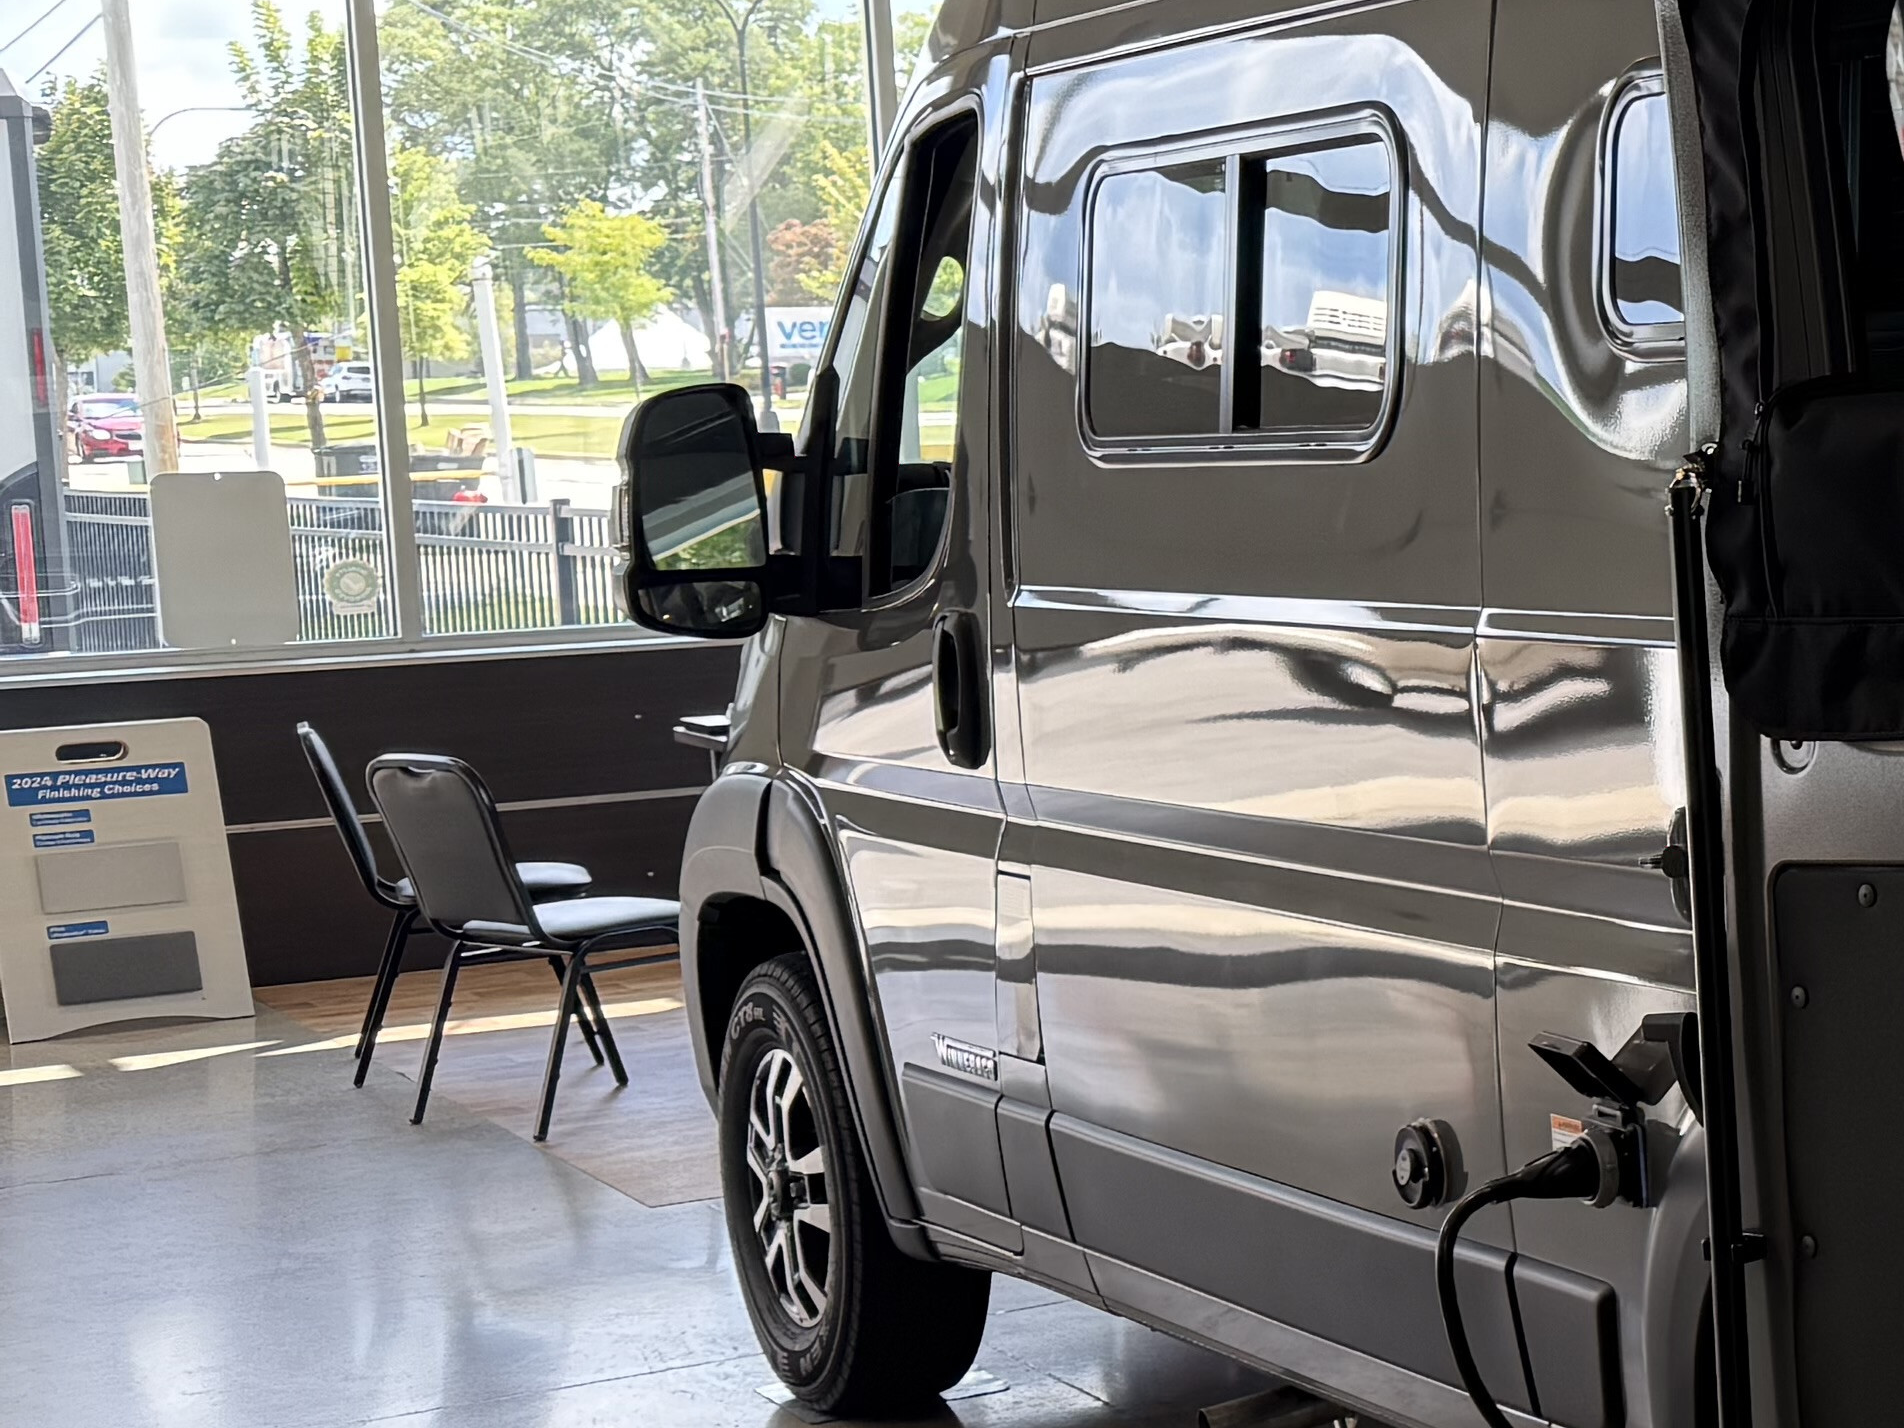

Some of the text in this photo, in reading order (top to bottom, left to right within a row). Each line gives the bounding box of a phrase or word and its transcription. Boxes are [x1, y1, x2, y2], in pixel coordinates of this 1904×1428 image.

[11, 767, 180, 789] 2024 Pleasure-Way
[38, 782, 159, 800] Finishing Choices
